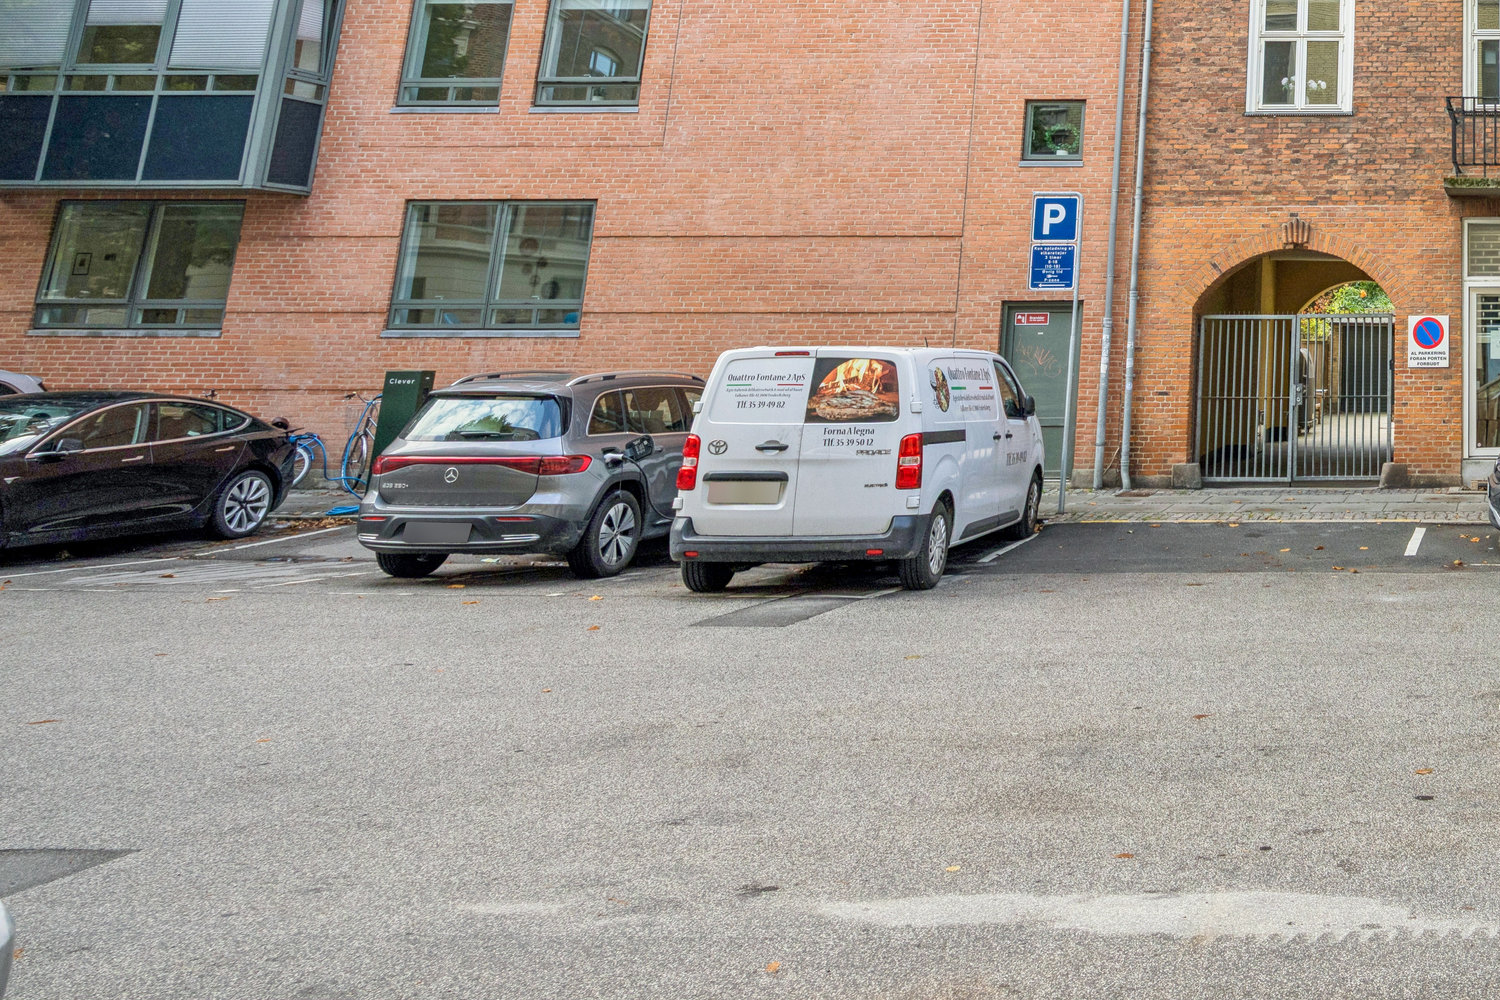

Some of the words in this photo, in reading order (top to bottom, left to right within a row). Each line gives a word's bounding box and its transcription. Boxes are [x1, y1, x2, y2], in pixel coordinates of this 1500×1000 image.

[1042, 203, 1066, 235] P
[757, 373, 786, 381] Fontane
[792, 373, 806, 382] ApS
[853, 427, 875, 436] legna
[823, 438, 834, 446] Tlf.
